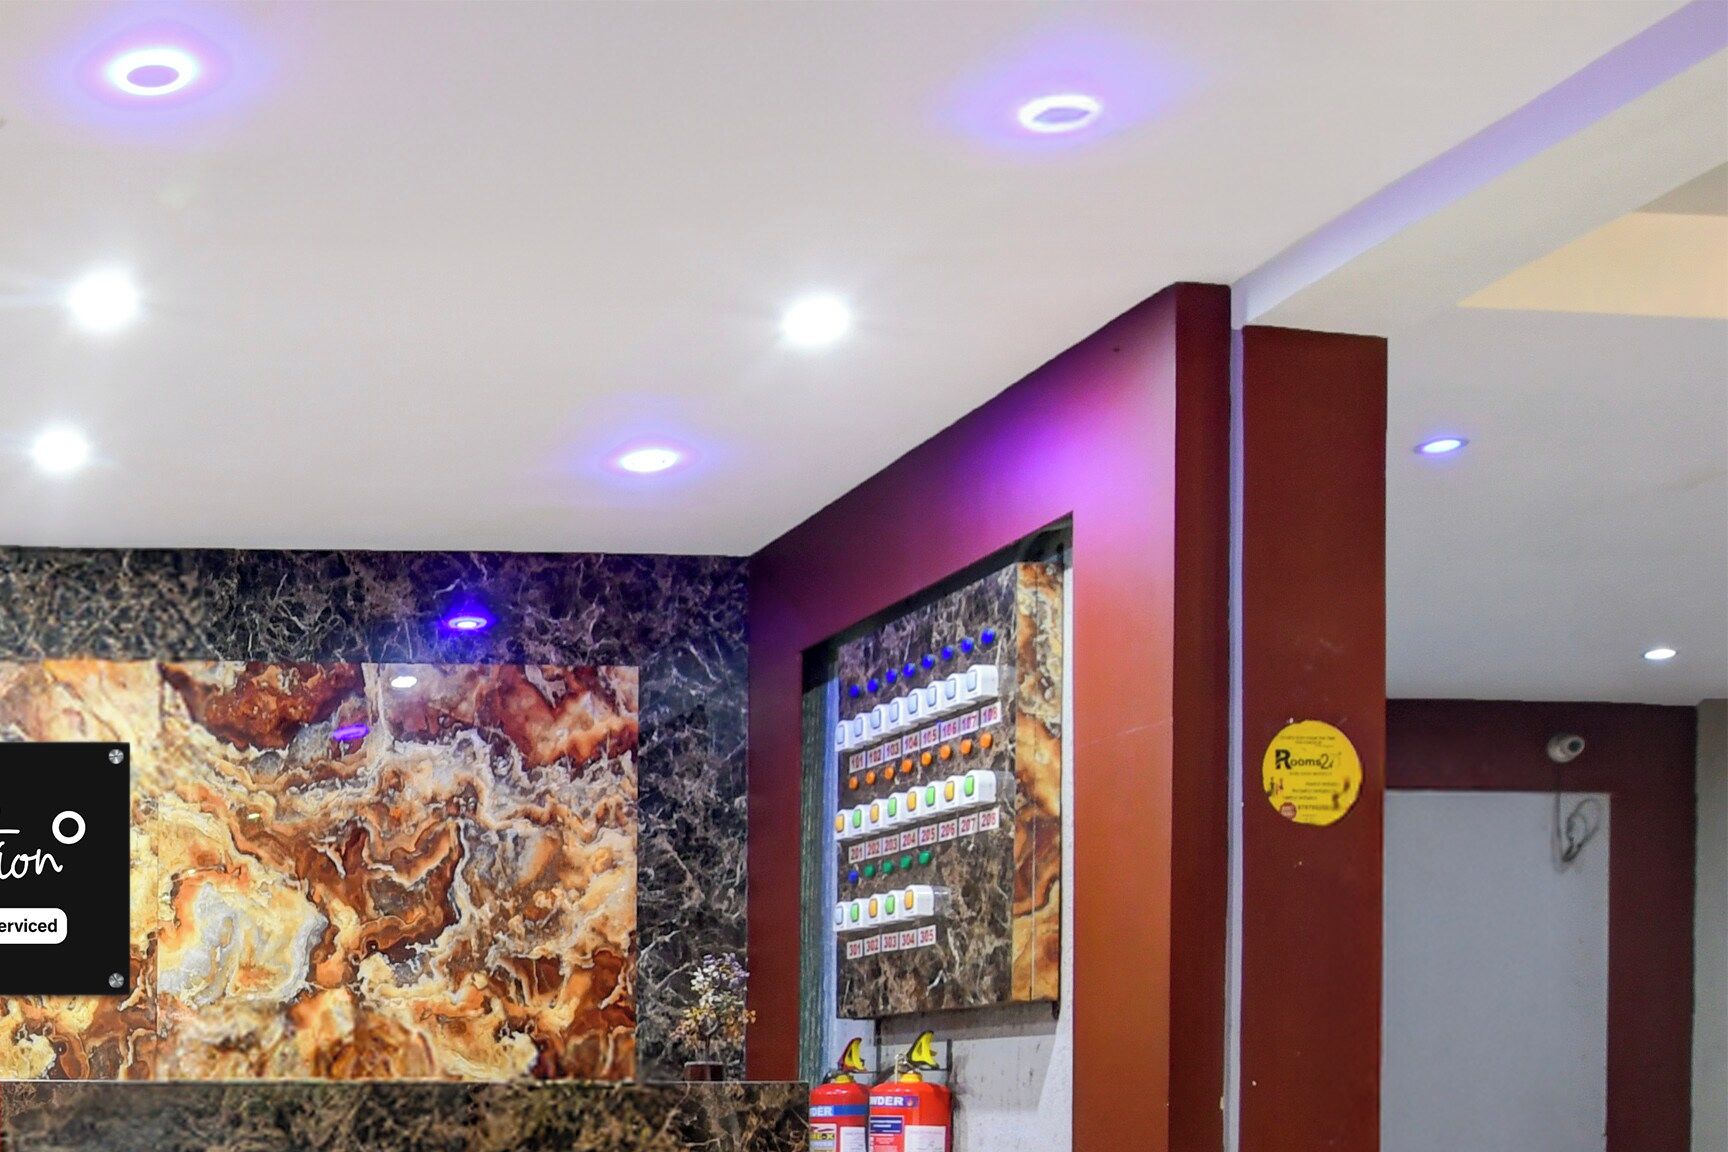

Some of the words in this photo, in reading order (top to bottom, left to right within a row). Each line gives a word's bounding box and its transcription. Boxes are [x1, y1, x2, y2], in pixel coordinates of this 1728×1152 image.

[905, 735, 918, 751] 104
[962, 715, 977, 731] 107
[851, 847, 862, 861] 201
[867, 841, 880, 856] 202
[884, 837, 897, 852] 203
[902, 832, 916, 847] 204
[922, 827, 936, 843] 205
[940, 822, 955, 838] 206
[961, 817, 976, 833] 207
[981, 812, 997, 827] 208
[849, 943, 861, 957] 301
[866, 938, 879, 952] 302
[884, 935, 897, 949] 303
[901, 932, 915, 947] 304
[920, 929, 934, 943] 305
